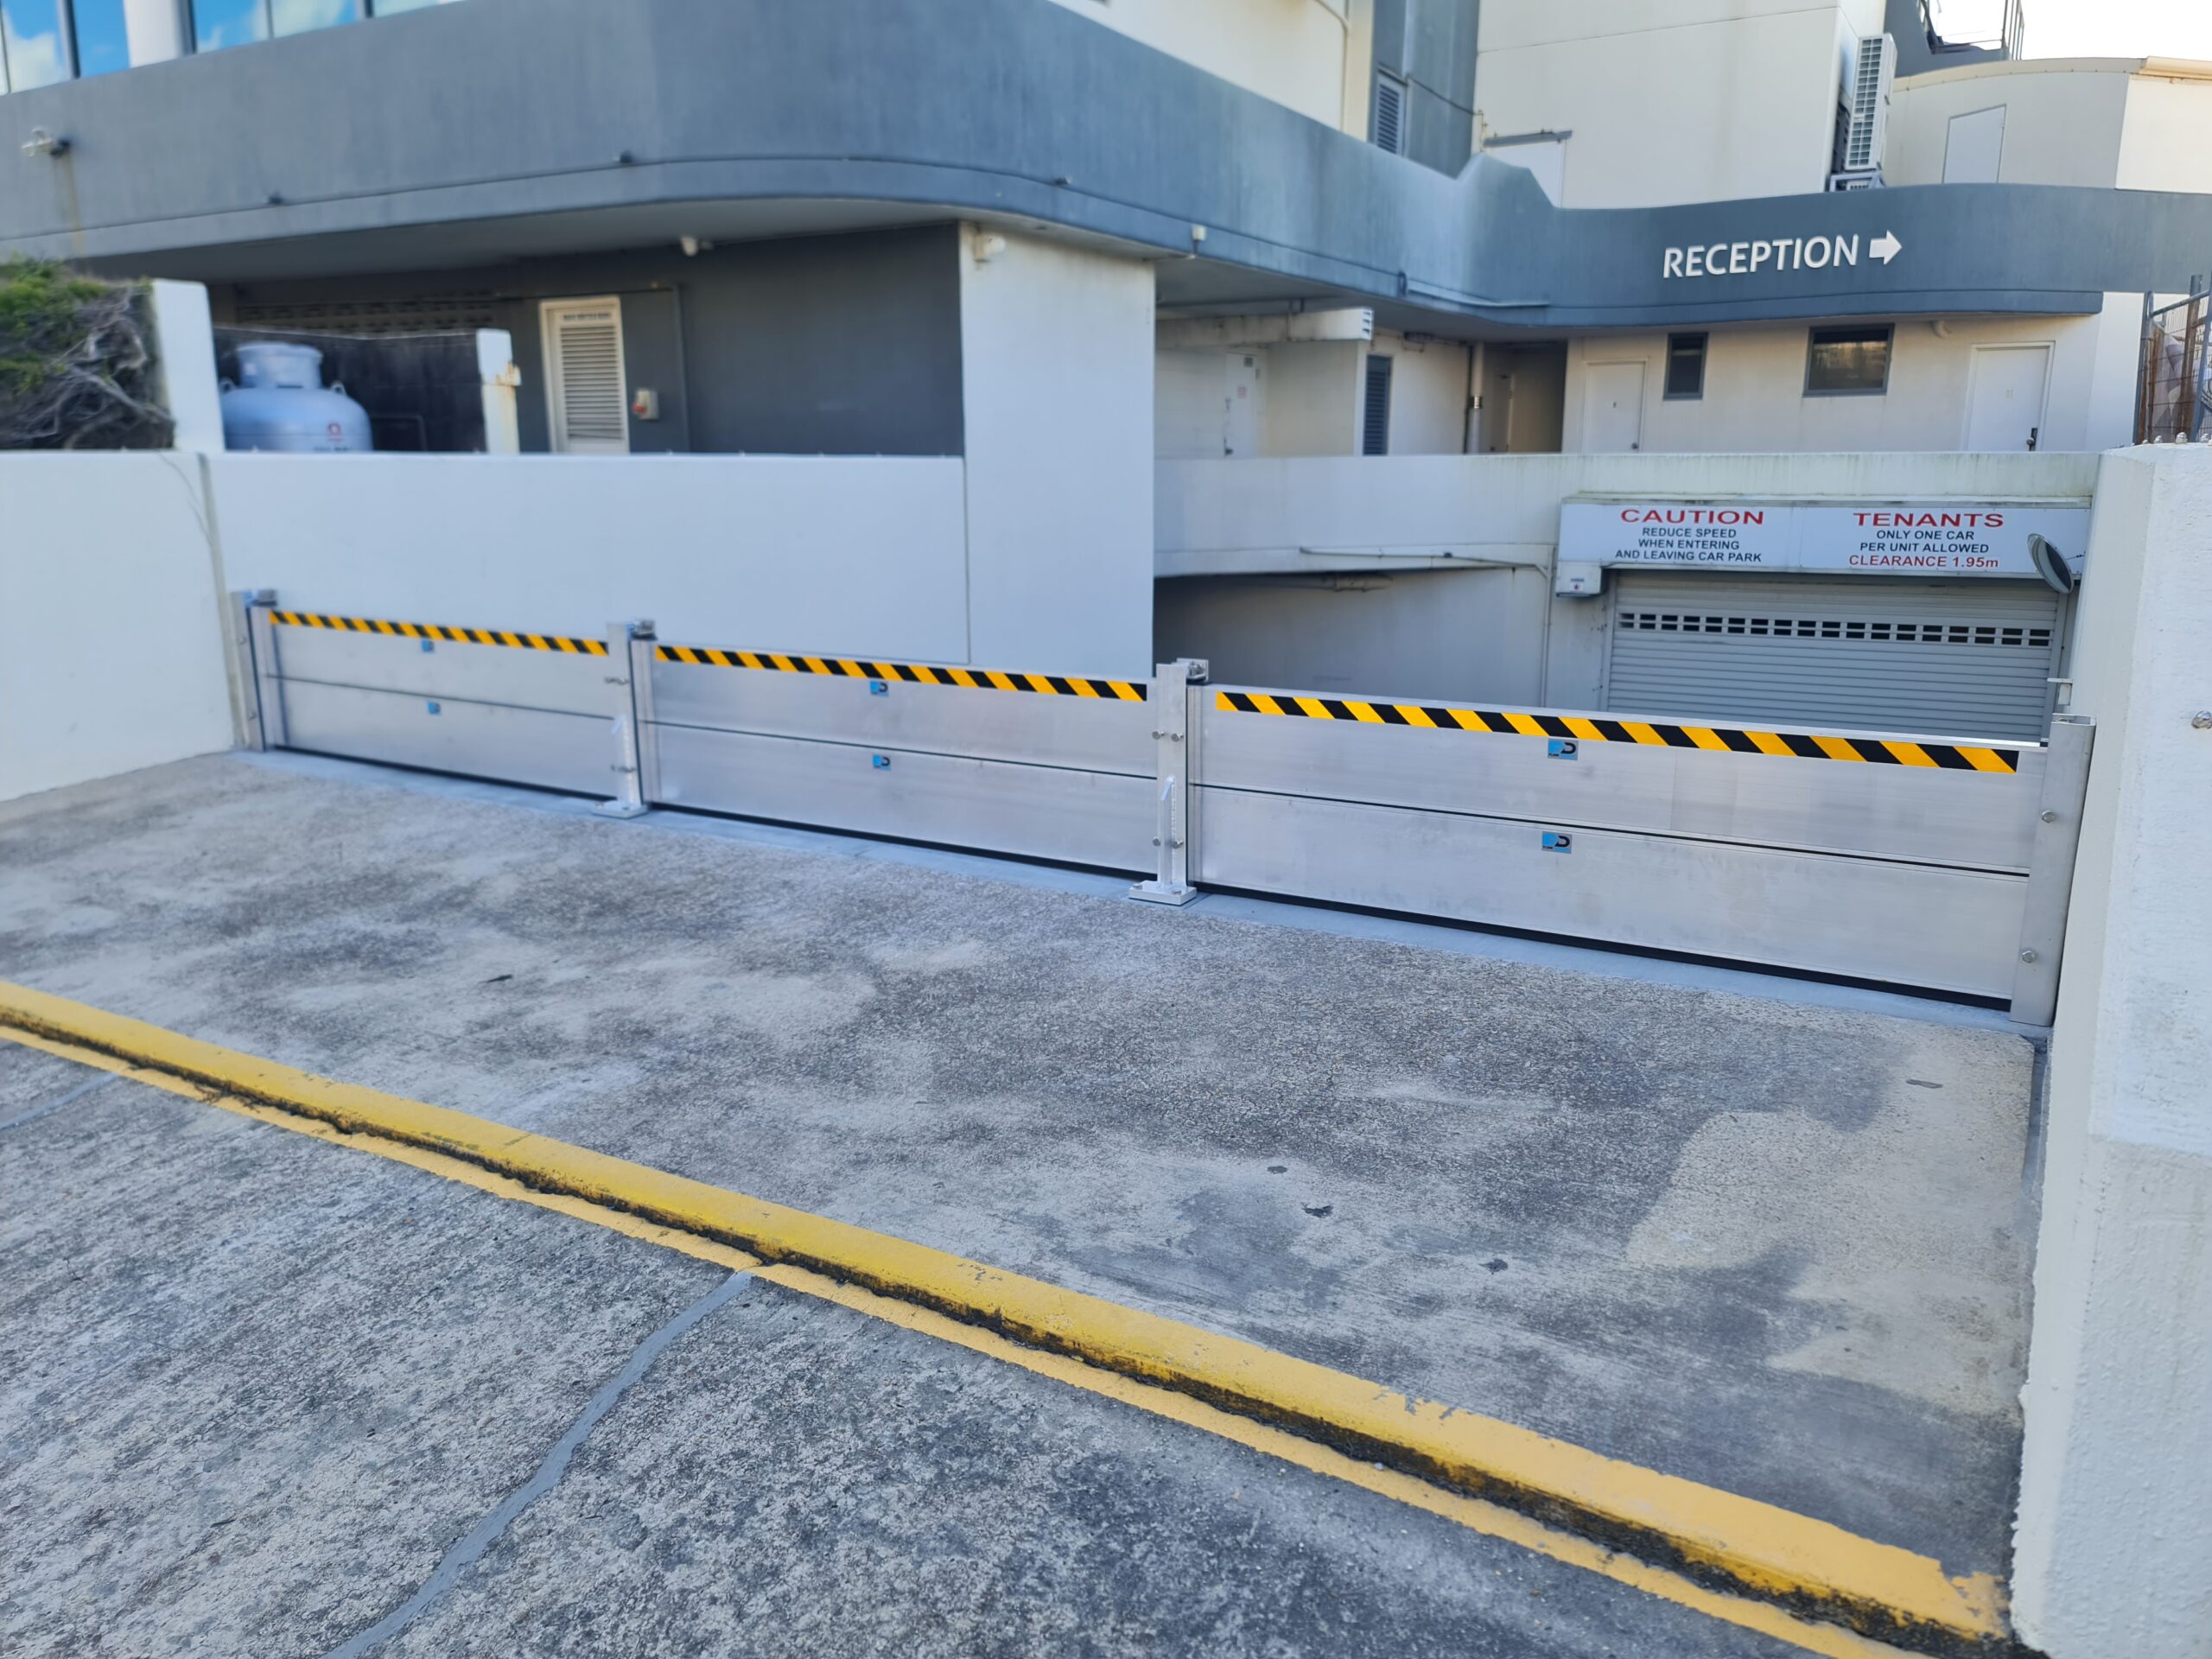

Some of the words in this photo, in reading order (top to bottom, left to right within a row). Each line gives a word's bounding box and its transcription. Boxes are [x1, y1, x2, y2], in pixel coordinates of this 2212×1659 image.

[1663, 233, 1859, 278] RECEPTION
[1621, 509, 1764, 524] CAUTION
[1853, 513, 2004, 527] TENANTS
[1643, 527, 1692, 537] REDUCE
[1695, 528, 1737, 538] SPEED
[1876, 530, 1911, 540] ONLY
[1914, 531, 1942, 540] ONE
[1946, 531, 1975, 541] CAR
[1638, 539, 1674, 549] WHEN
[1677, 540, 1739, 550] ENTERING
[1859, 543, 1886, 552] PER
[1889, 543, 1920, 552] UNIT
[1922, 543, 1989, 554] ALLOWED
[1615, 550, 1640, 559] AND
[1643, 550, 1694, 561] LEAVING
[1698, 551, 1725, 562] CAR
[1728, 552, 1762, 563] PARK
[1849, 555, 1947, 567] CLEARANCE
[1952, 556, 1999, 568] 1.95m
